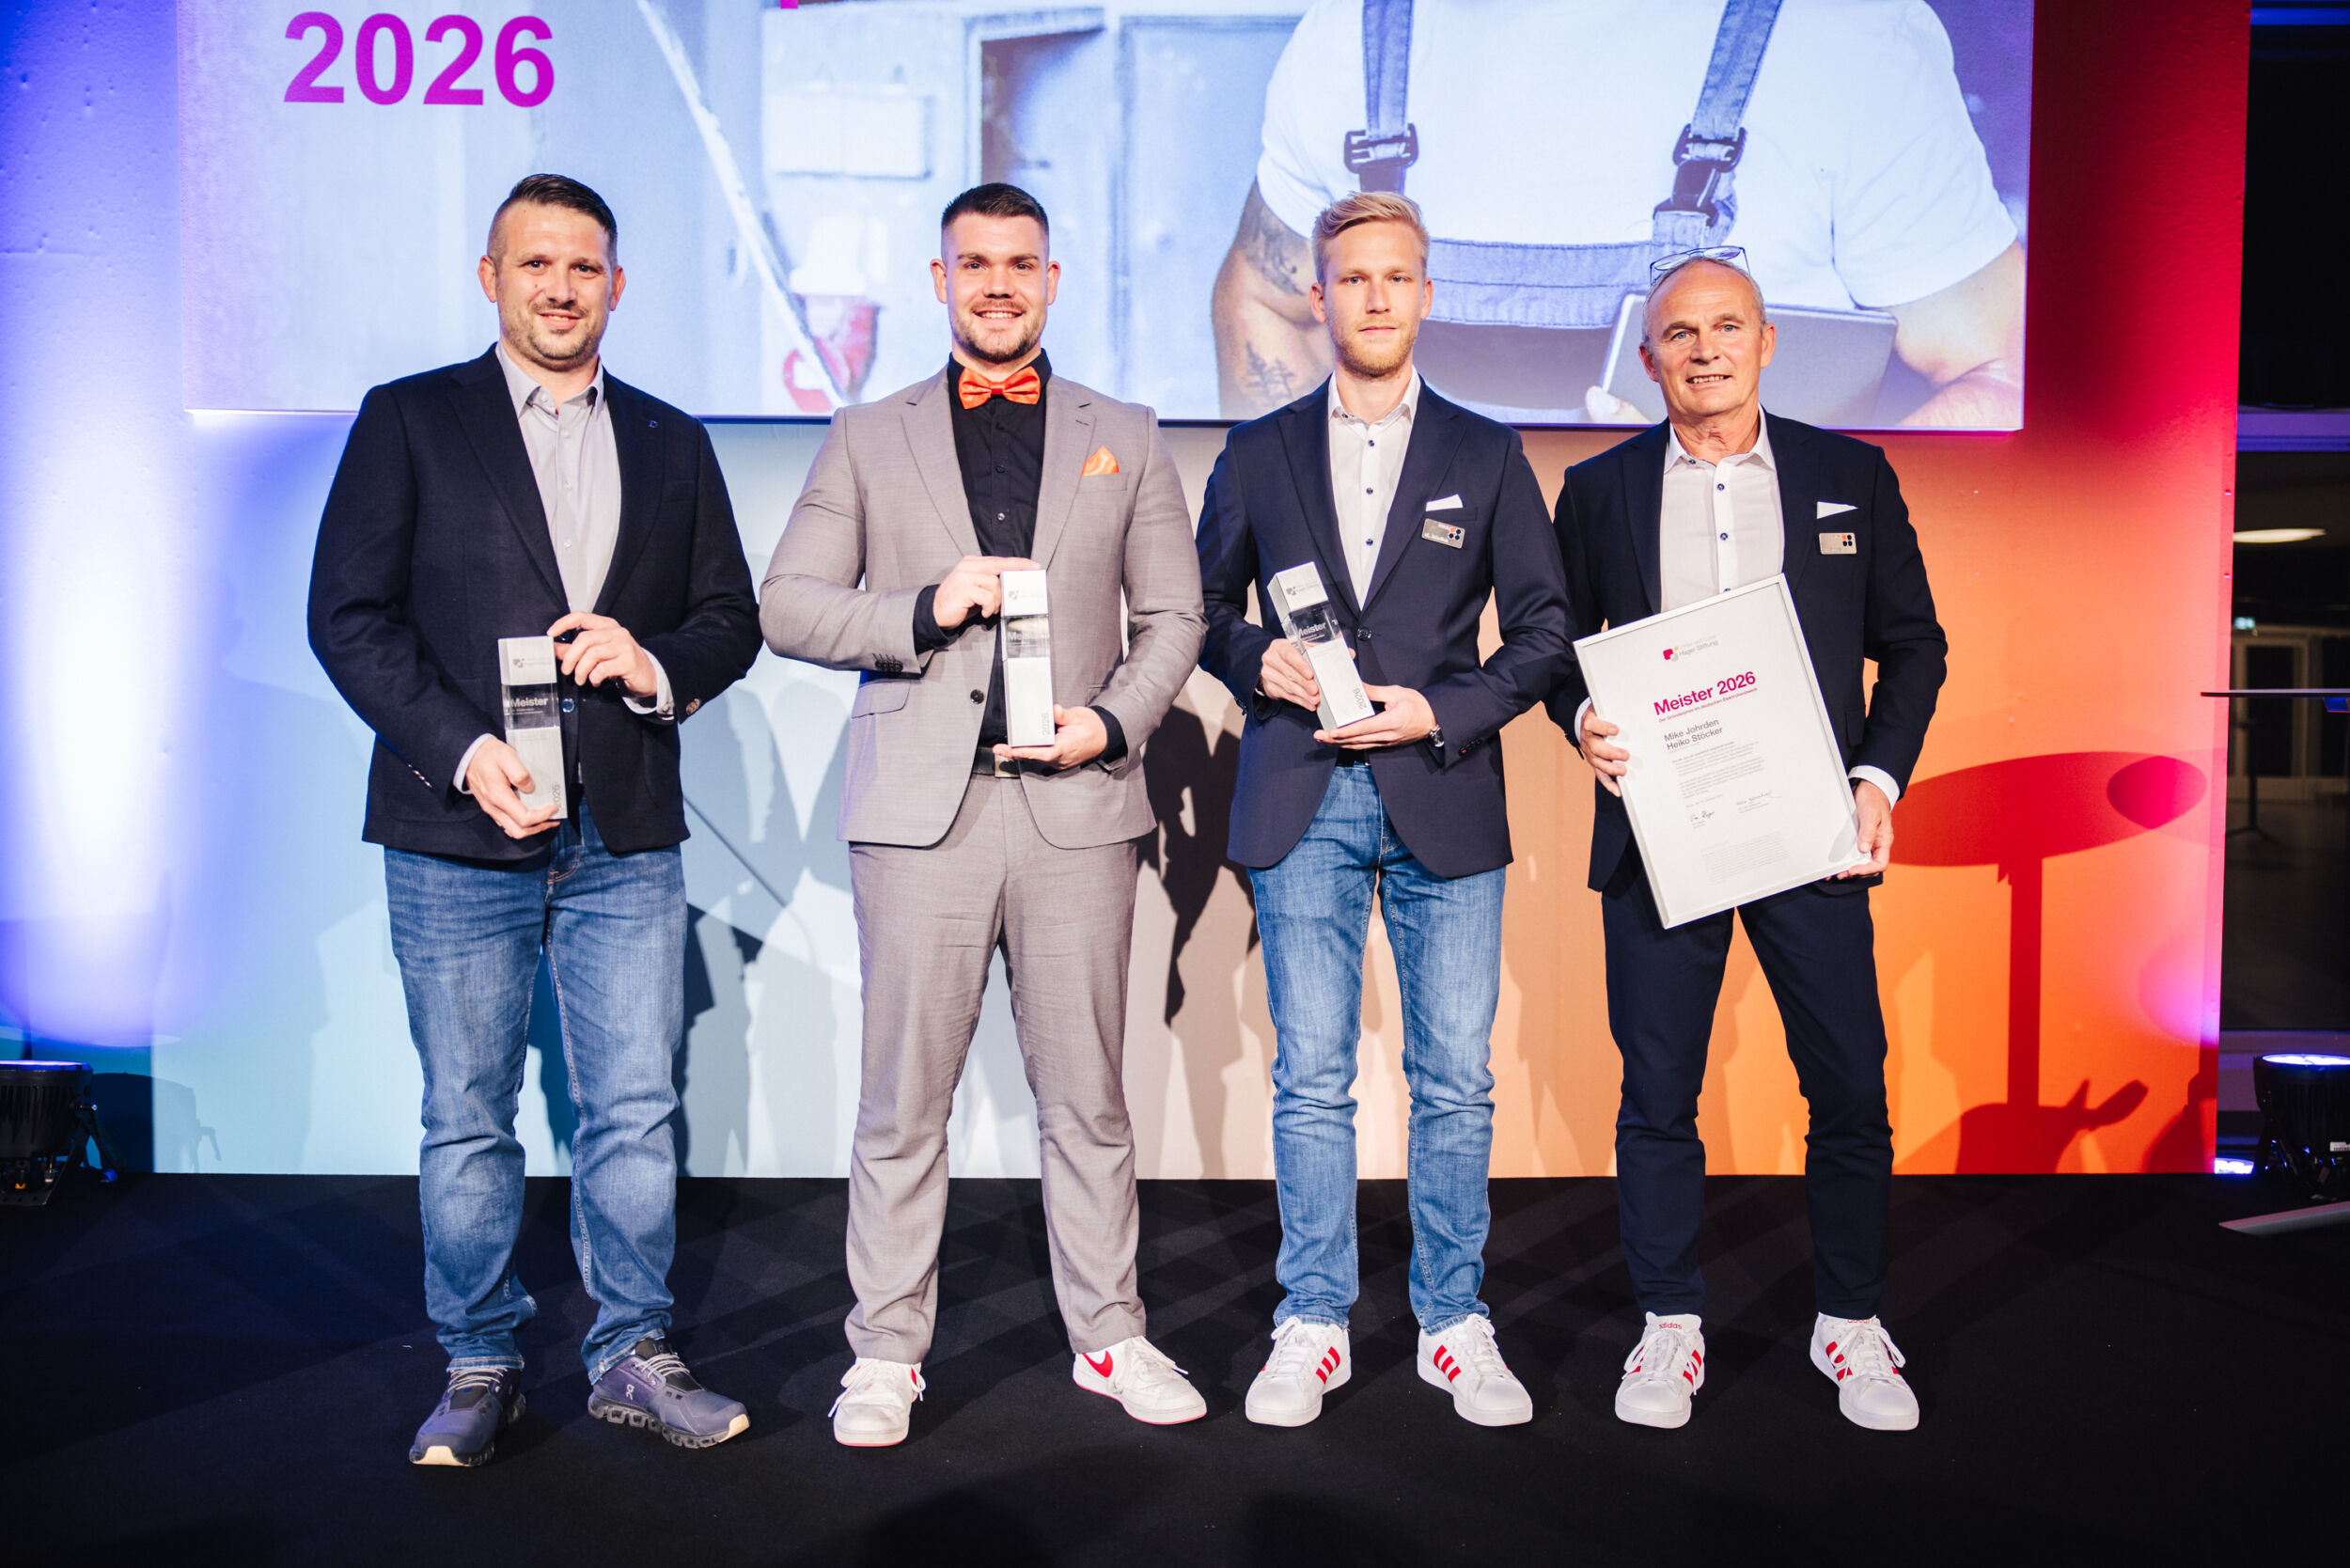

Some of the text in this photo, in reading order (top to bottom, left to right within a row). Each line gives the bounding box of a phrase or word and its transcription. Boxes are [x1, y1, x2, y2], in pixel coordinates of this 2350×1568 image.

[283, 11, 555, 107] 2026
[510, 697, 549, 708] Meister
[1354, 687, 1368, 710] 2026
[1653, 671, 1756, 715] Meister 2026
[1664, 719, 1720, 743] Mike Johrden
[1667, 738, 1691, 750] Heiko
